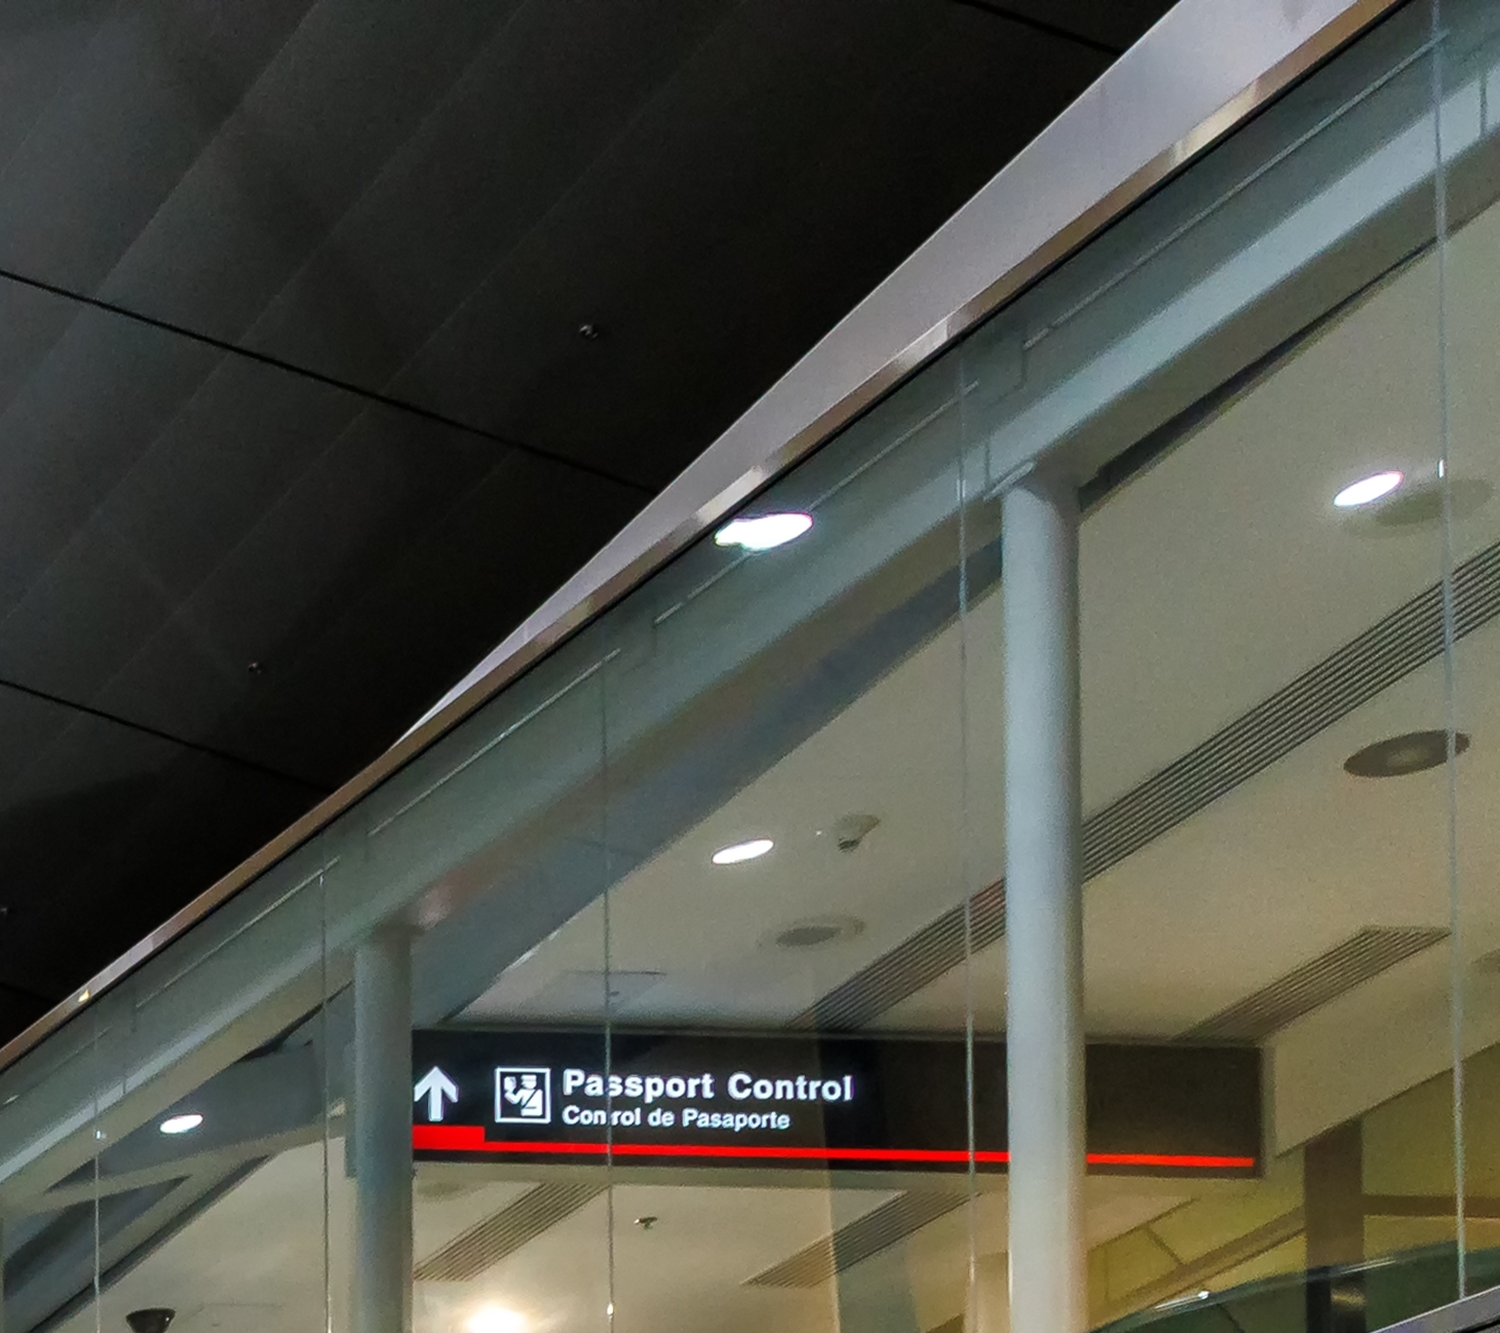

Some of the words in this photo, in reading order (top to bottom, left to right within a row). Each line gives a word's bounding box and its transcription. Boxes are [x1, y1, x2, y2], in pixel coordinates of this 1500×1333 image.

[563, 1069, 714, 1102] Passport
[728, 1072, 853, 1101] Control
[562, 1105, 640, 1126] Conrol
[647, 1107, 675, 1127] de
[681, 1109, 790, 1132] Pasaporte
